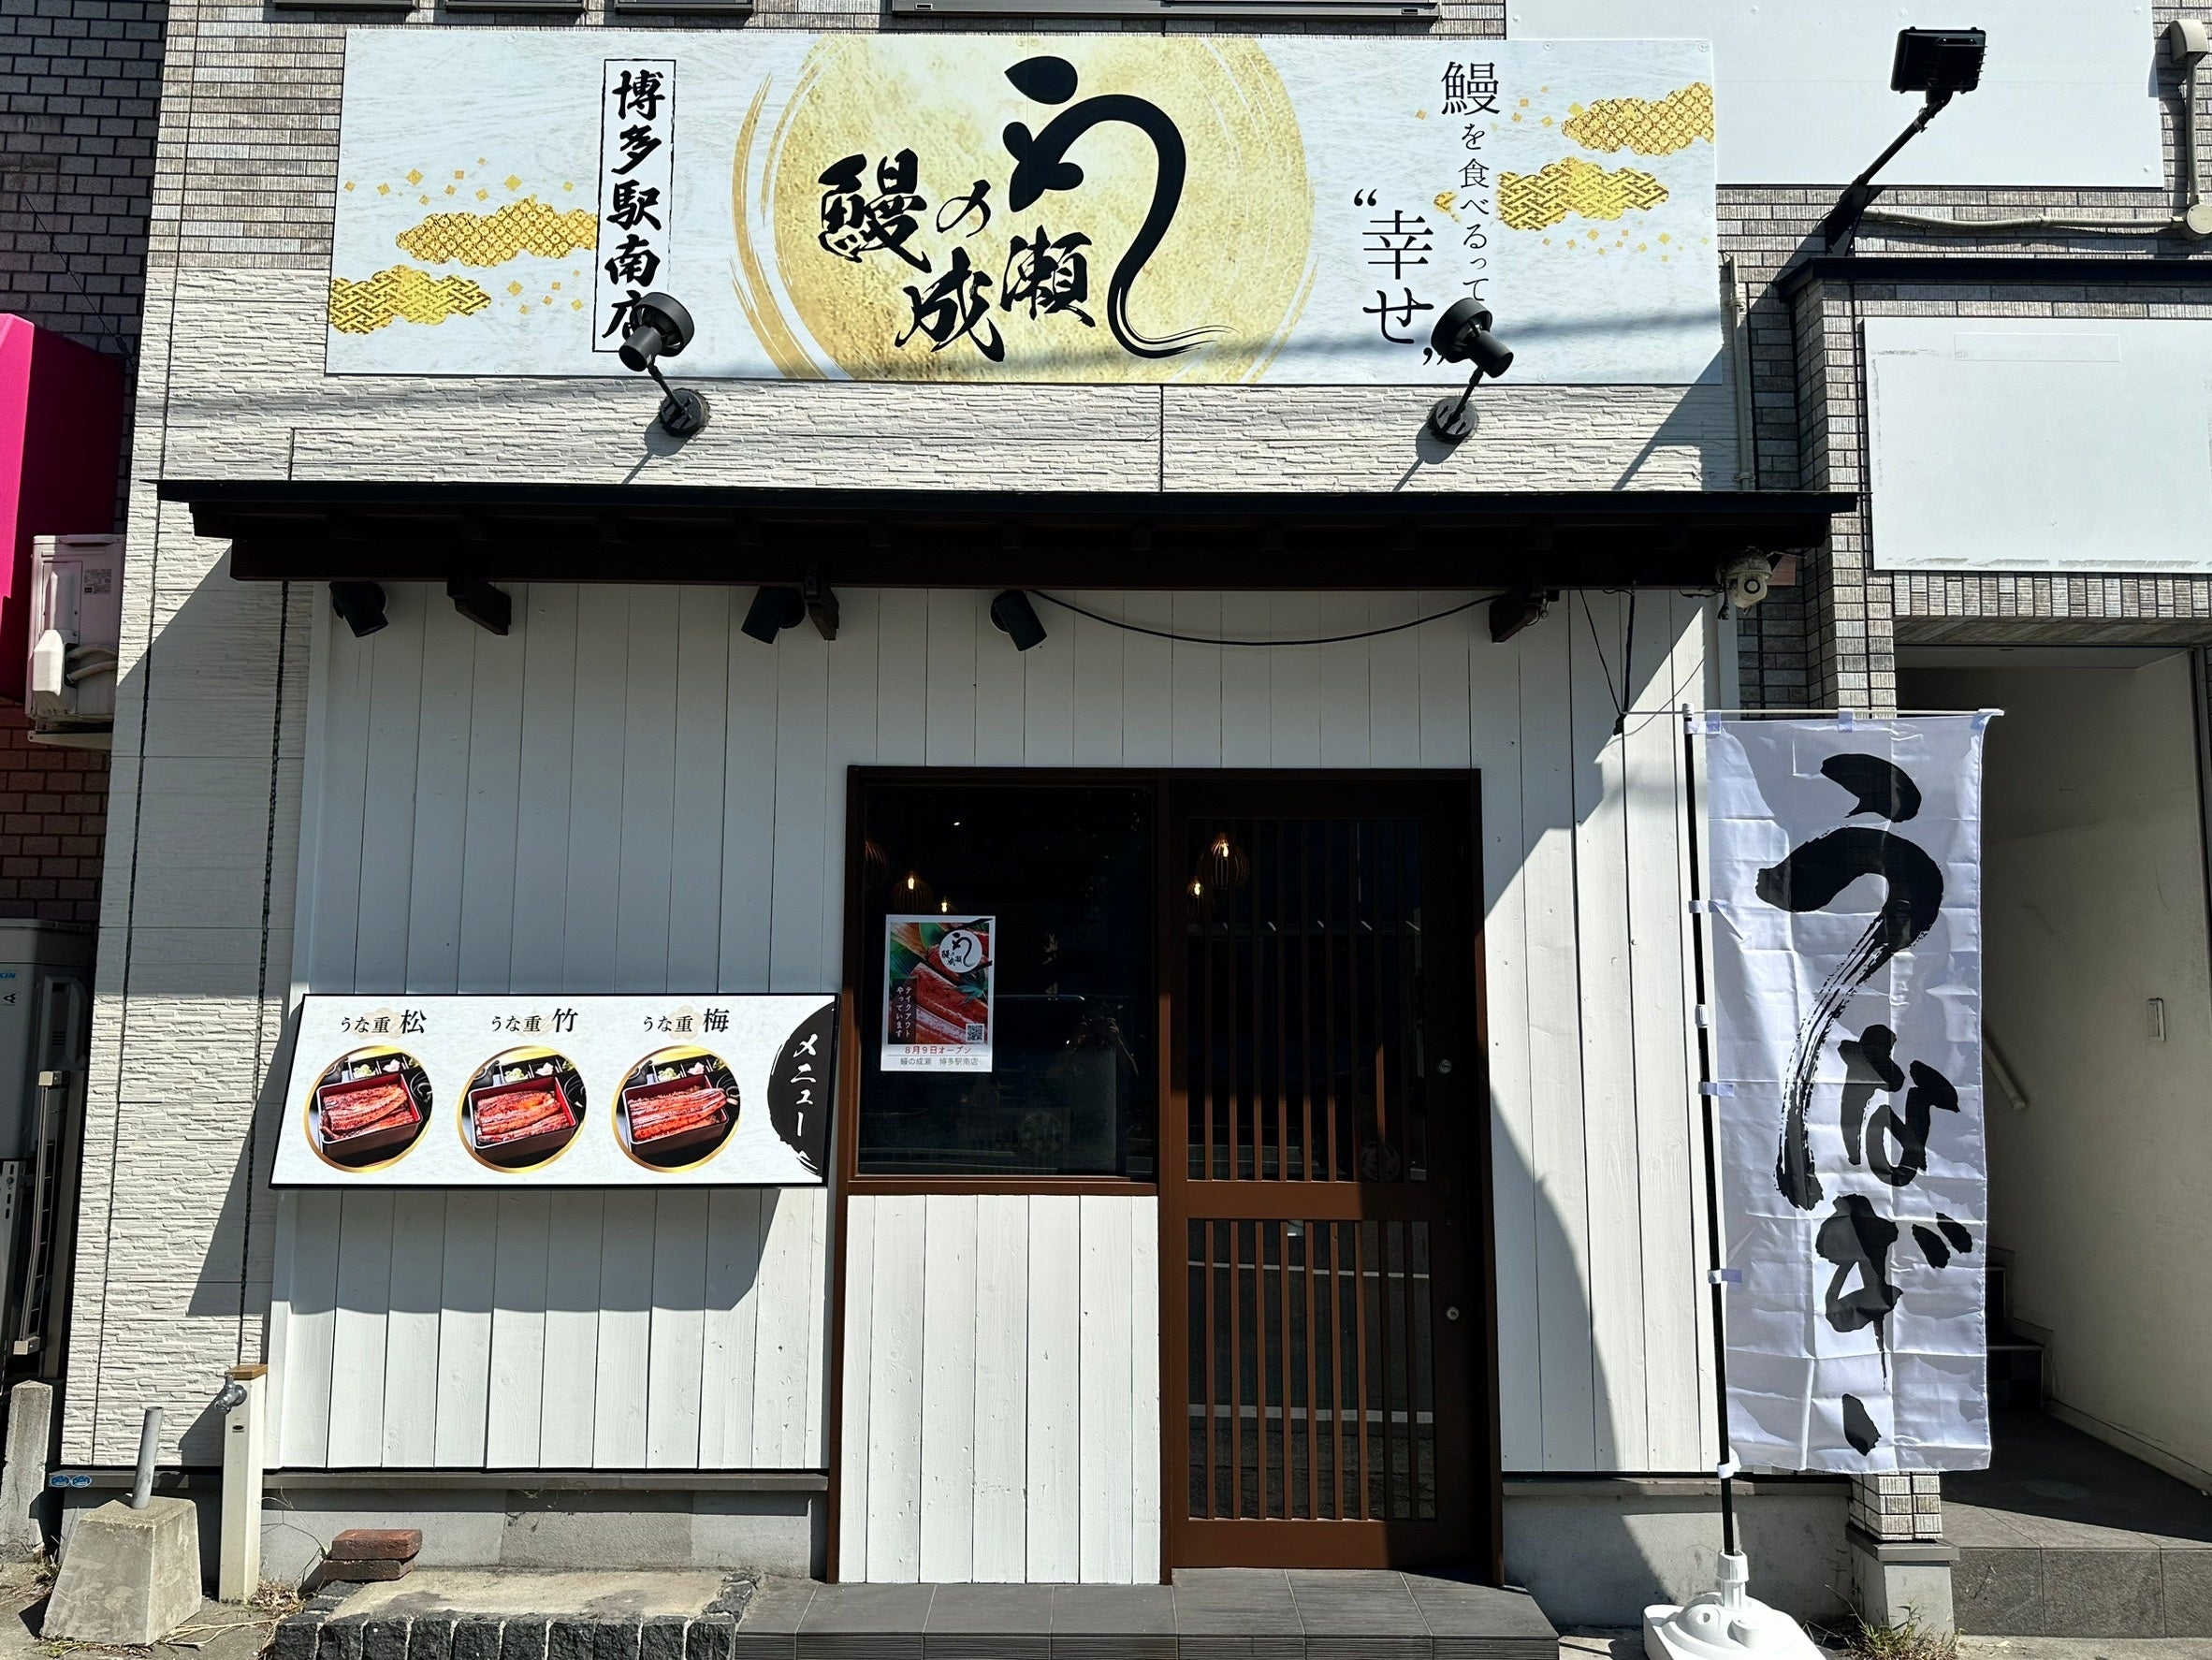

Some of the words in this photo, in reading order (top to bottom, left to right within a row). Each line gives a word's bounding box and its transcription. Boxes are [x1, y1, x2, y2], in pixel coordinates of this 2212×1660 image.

[1441, 62, 1500, 301] 鰻を食べるって
[341, 1016, 390, 1034] うな重
[399, 1010, 427, 1034] 松
[491, 1016, 543, 1033] うな重
[552, 1009, 578, 1033] 竹
[643, 1015, 694, 1033] うな重
[702, 1008, 730, 1033] 梅
[895, 986, 904, 1038] やっています
[790, 1033, 819, 1137] メニュー
[1756, 753, 1972, 1456] うなぎ
